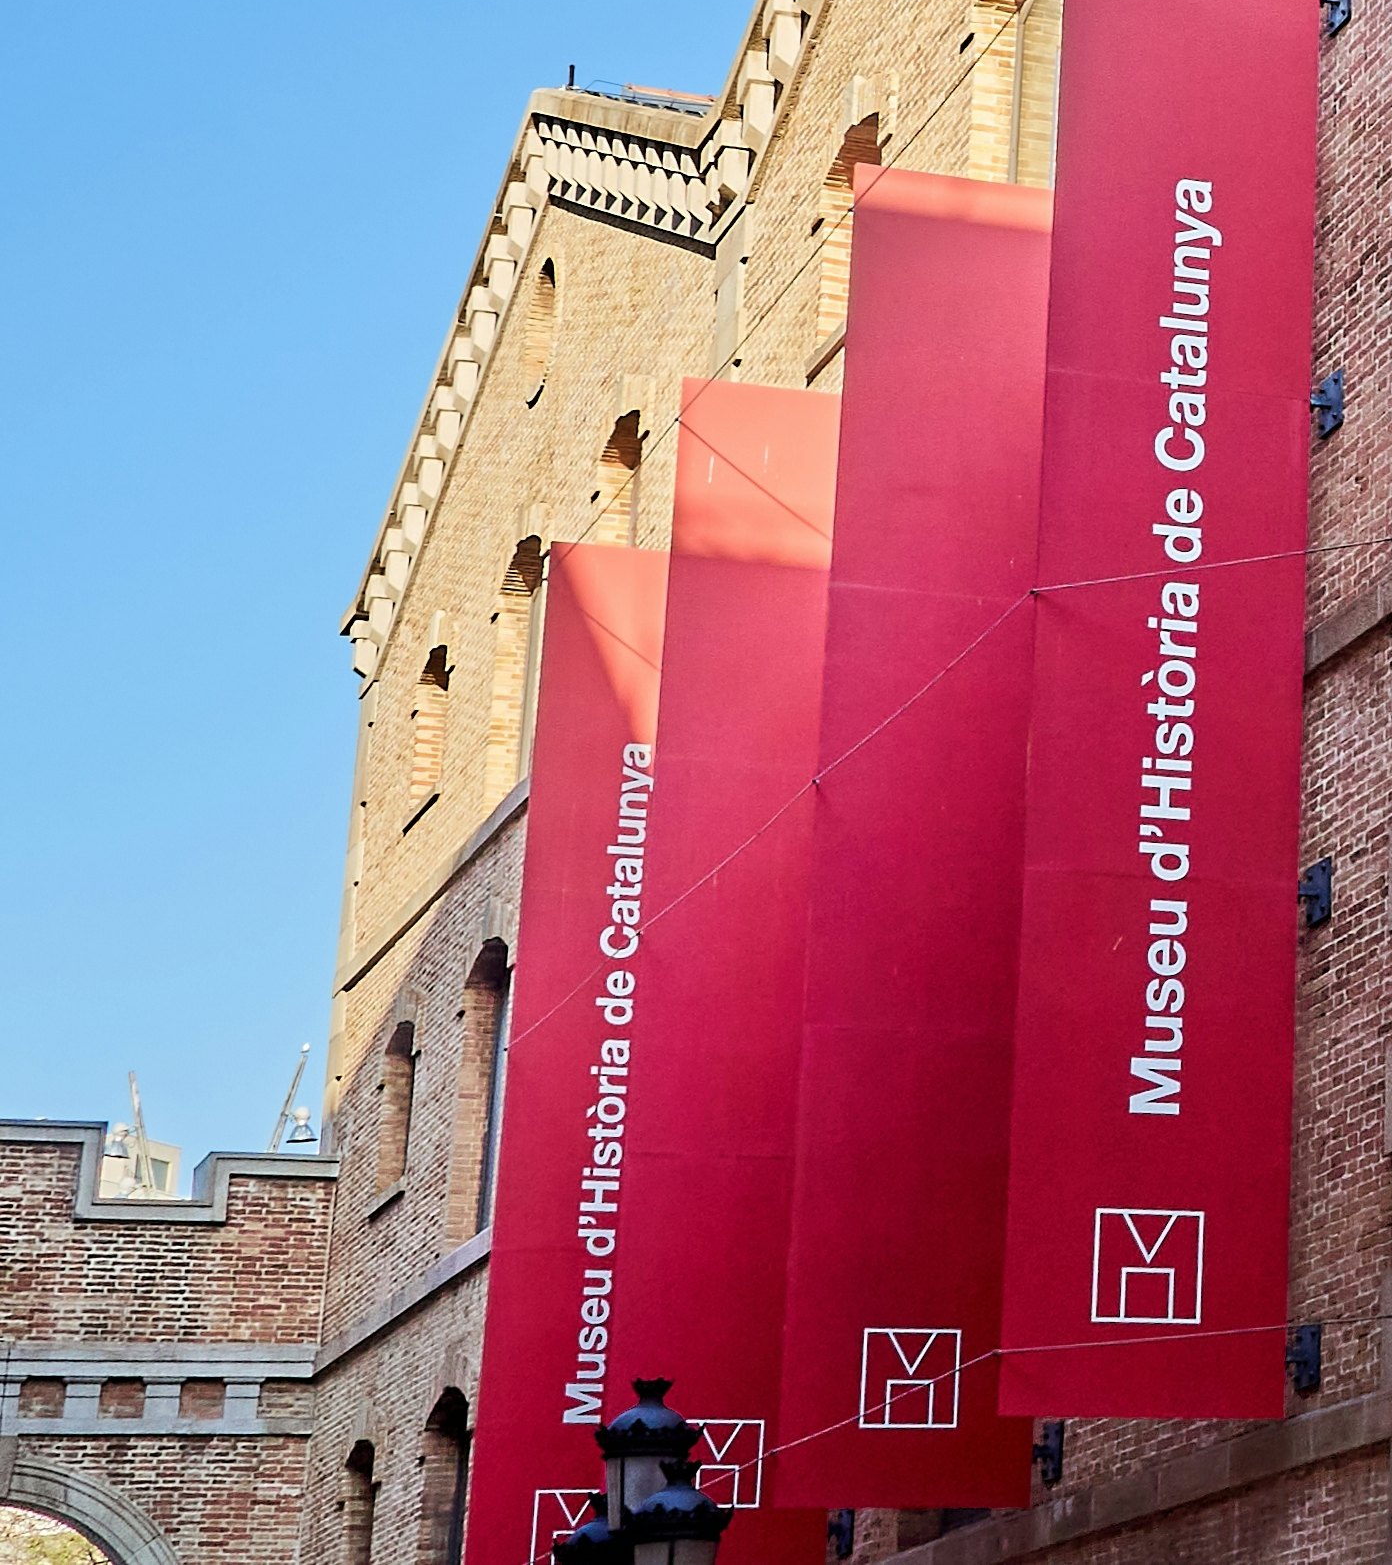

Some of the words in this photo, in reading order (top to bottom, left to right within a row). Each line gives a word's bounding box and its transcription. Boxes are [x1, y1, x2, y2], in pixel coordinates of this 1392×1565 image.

[1154, 178, 1223, 472] Catalunya
[1152, 488, 1204, 563] de
[1138, 581, 1200, 882] d'Història
[599, 742, 654, 959] Catalunya
[595, 970, 636, 1026] de
[1128, 899, 1188, 1116] Museu
[577, 1039, 631, 1257] d'Història
[562, 1269, 613, 1424] Museu
